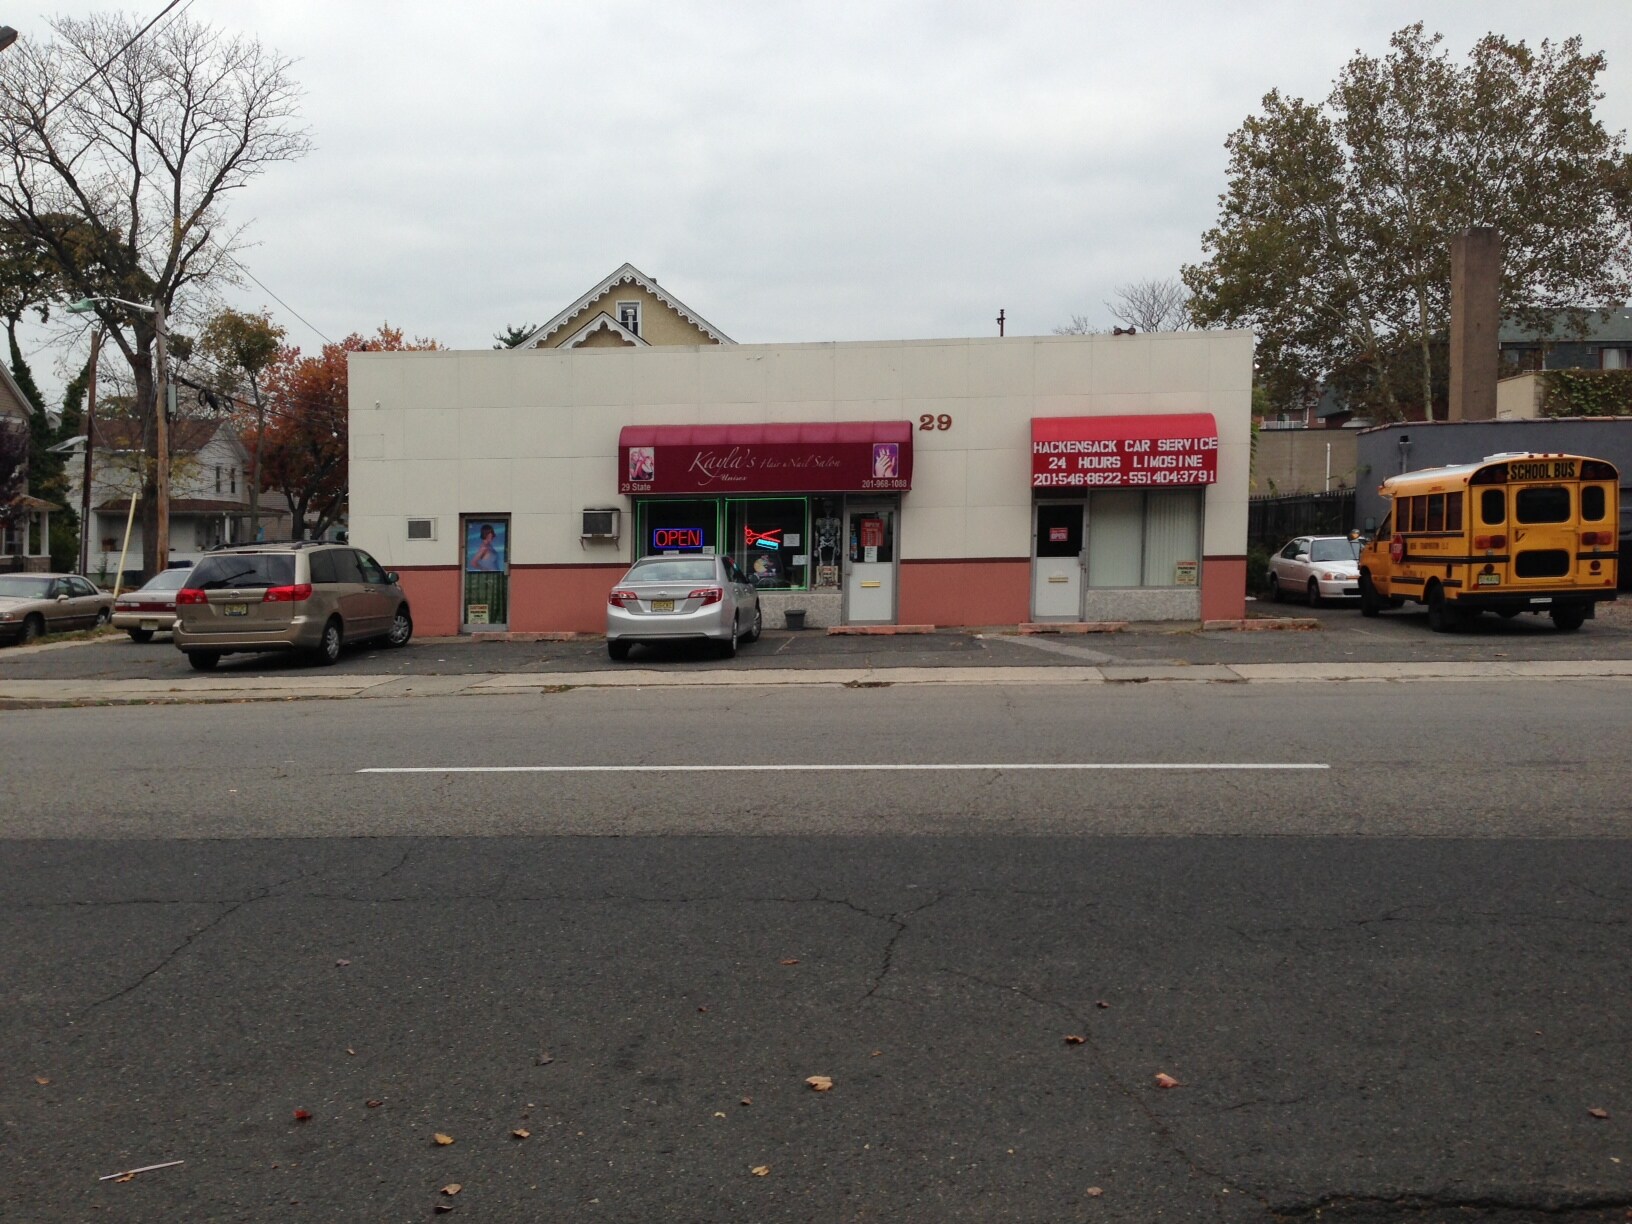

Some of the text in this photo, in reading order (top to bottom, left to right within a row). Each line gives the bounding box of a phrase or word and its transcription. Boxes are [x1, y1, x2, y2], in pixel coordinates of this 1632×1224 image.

[919, 414, 952, 431] 29
[1033, 437, 1218, 454] HACKENSACK CAR SERVICE
[688, 446, 756, 485] Kayla's
[760, 457, 781, 468] Hair
[787, 454, 814, 468] Nail
[812, 455, 841, 468] Salon
[1048, 455, 1203, 469] 24 HOURS LIMOSINE
[1510, 462, 1575, 480] SCHOOL BUS
[621, 482, 652, 492] 29 State
[861, 479, 907, 488] 201-968-1088
[655, 530, 700, 546] OPEN
